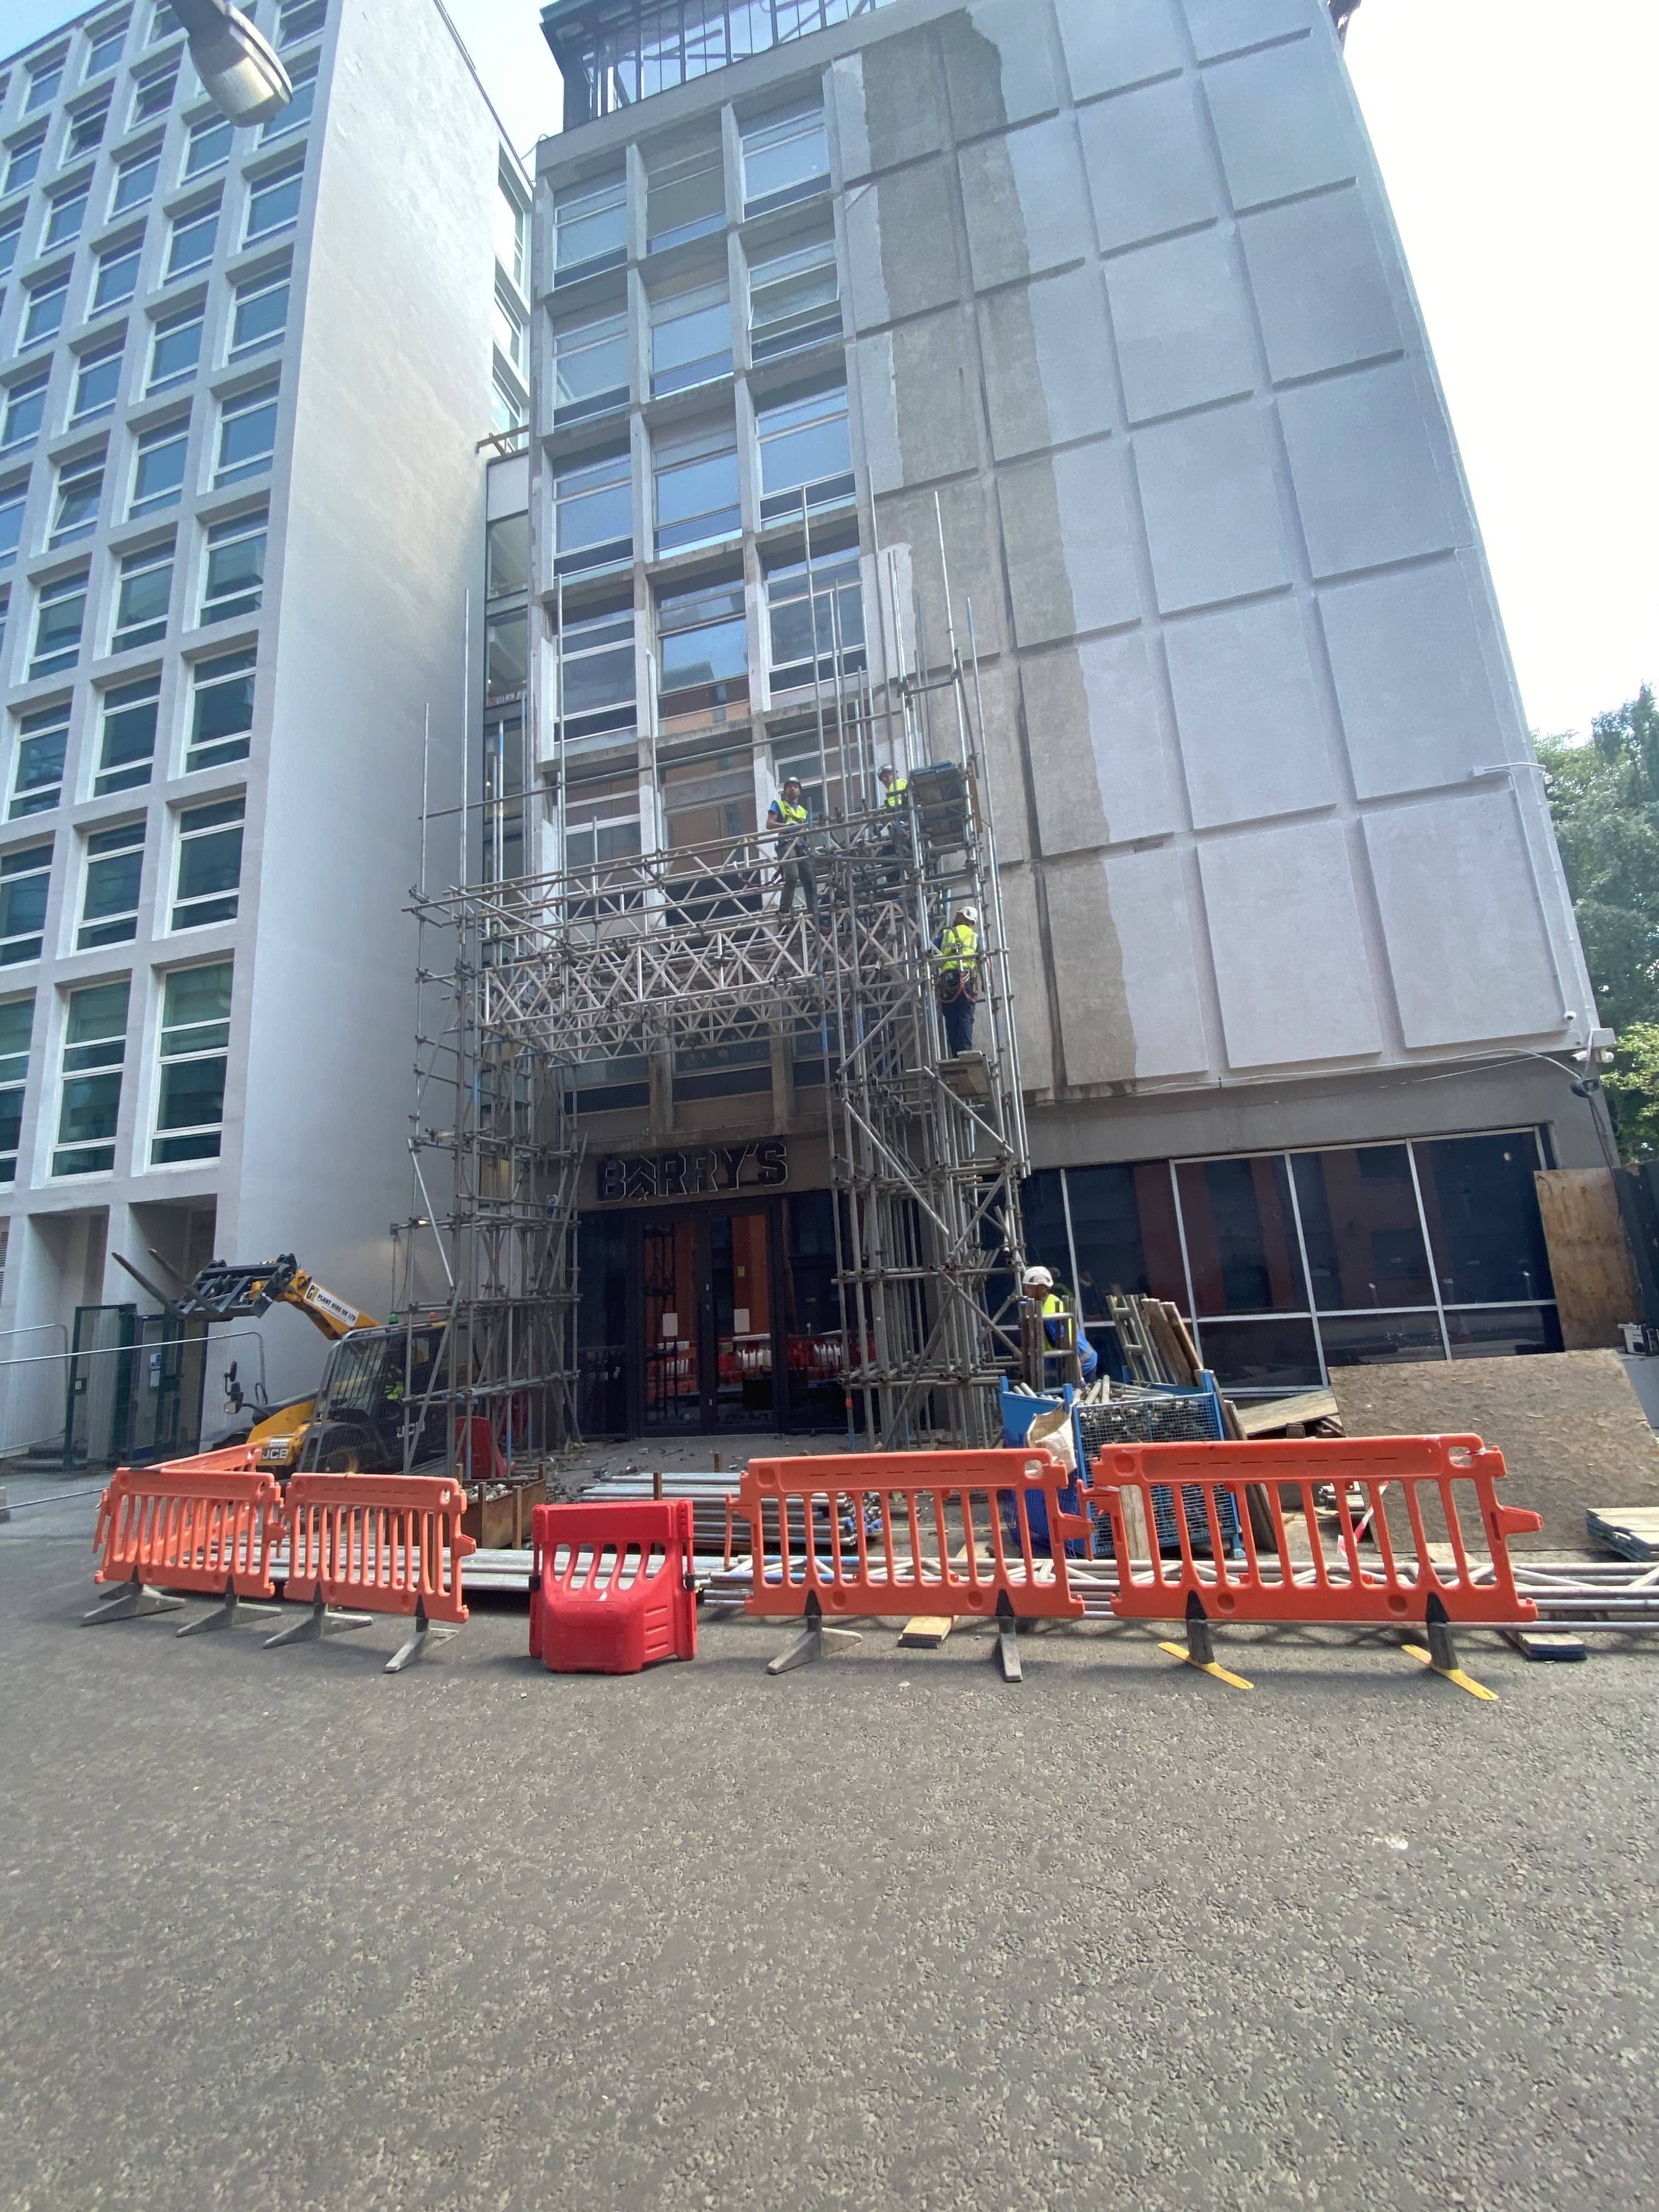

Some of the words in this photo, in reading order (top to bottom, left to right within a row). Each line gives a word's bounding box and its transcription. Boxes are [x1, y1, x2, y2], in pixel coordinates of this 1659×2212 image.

[597, 1139, 788, 1203] BARRY'S
[317, 1294, 331, 1305] PLANT
[348, 1312, 356, 1321] LTD
[262, 1449, 289, 1459] JCB
